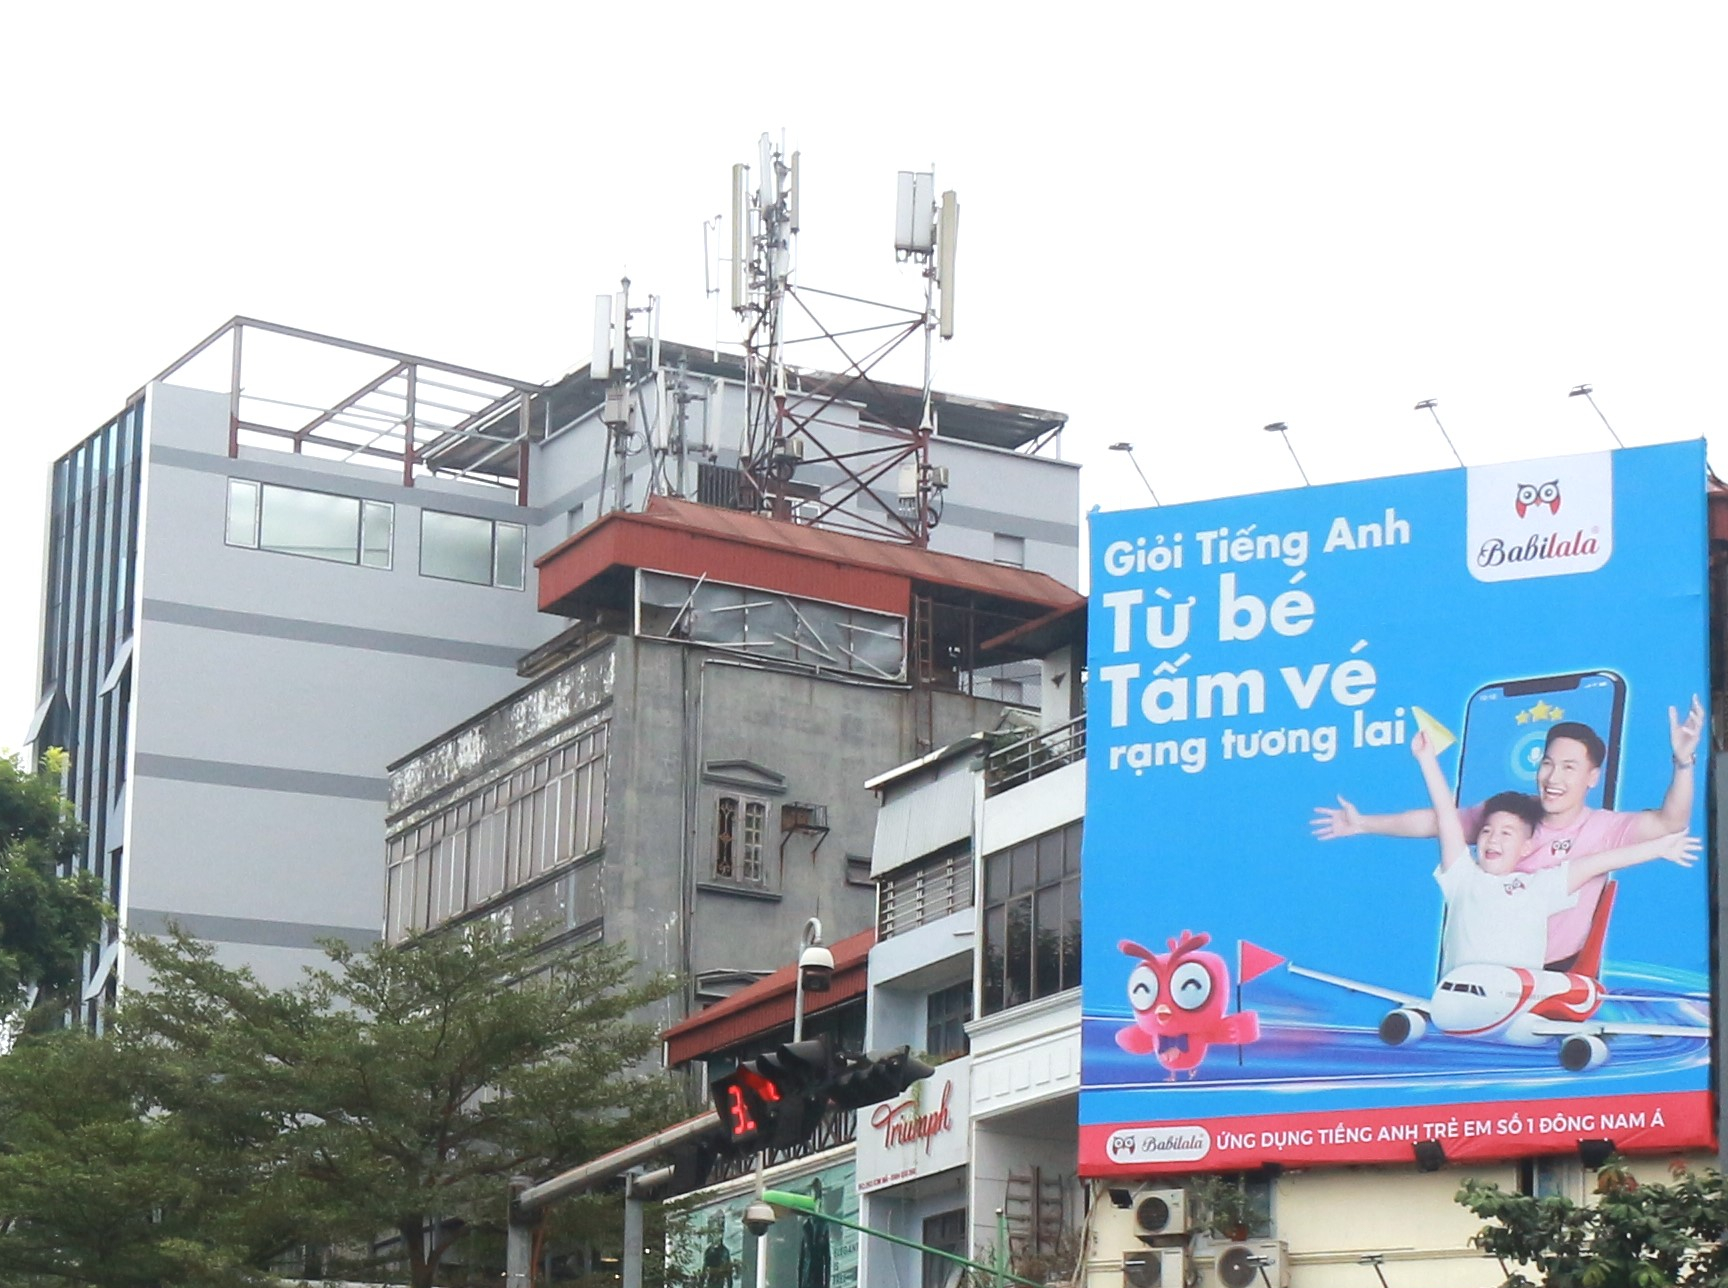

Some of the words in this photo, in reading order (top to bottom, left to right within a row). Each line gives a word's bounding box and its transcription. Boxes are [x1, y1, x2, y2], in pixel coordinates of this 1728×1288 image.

[1103, 532, 1183, 577] Giỏi
[1195, 523, 1309, 567] Tiếng
[1322, 507, 1411, 553] Anh
[1476, 528, 1599, 568] Babilala
[1102, 586, 1197, 653] Từ
[1218, 569, 1316, 642] bé
[1099, 652, 1265, 728] Tấm
[1279, 638, 1378, 710] vé
[1109, 736, 1207, 777] rạng
[1221, 725, 1338, 763] tương
[1353, 705, 1406, 749] lai
[872, 1079, 953, 1154] Triumph
[1141, 1133, 1203, 1153] Babilala
[1216, 1129, 1256, 1150] ỨNG
[1261, 1130, 1314, 1151] DỤNG
[1318, 1121, 1373, 1145] TIẾNG
[1377, 1123, 1419, 1142] ANH
[1423, 1117, 1460, 1140] TRẺ
[1464, 1119, 1493, 1137] EM
[1496, 1112, 1523, 1136] SỐ
[1526, 1117, 1534, 1134] 1
[1539, 1112, 1596, 1134] ĐÔNG
[1600, 1111, 1646, 1130] NAM
[1650, 1108, 1666, 1128] Á
